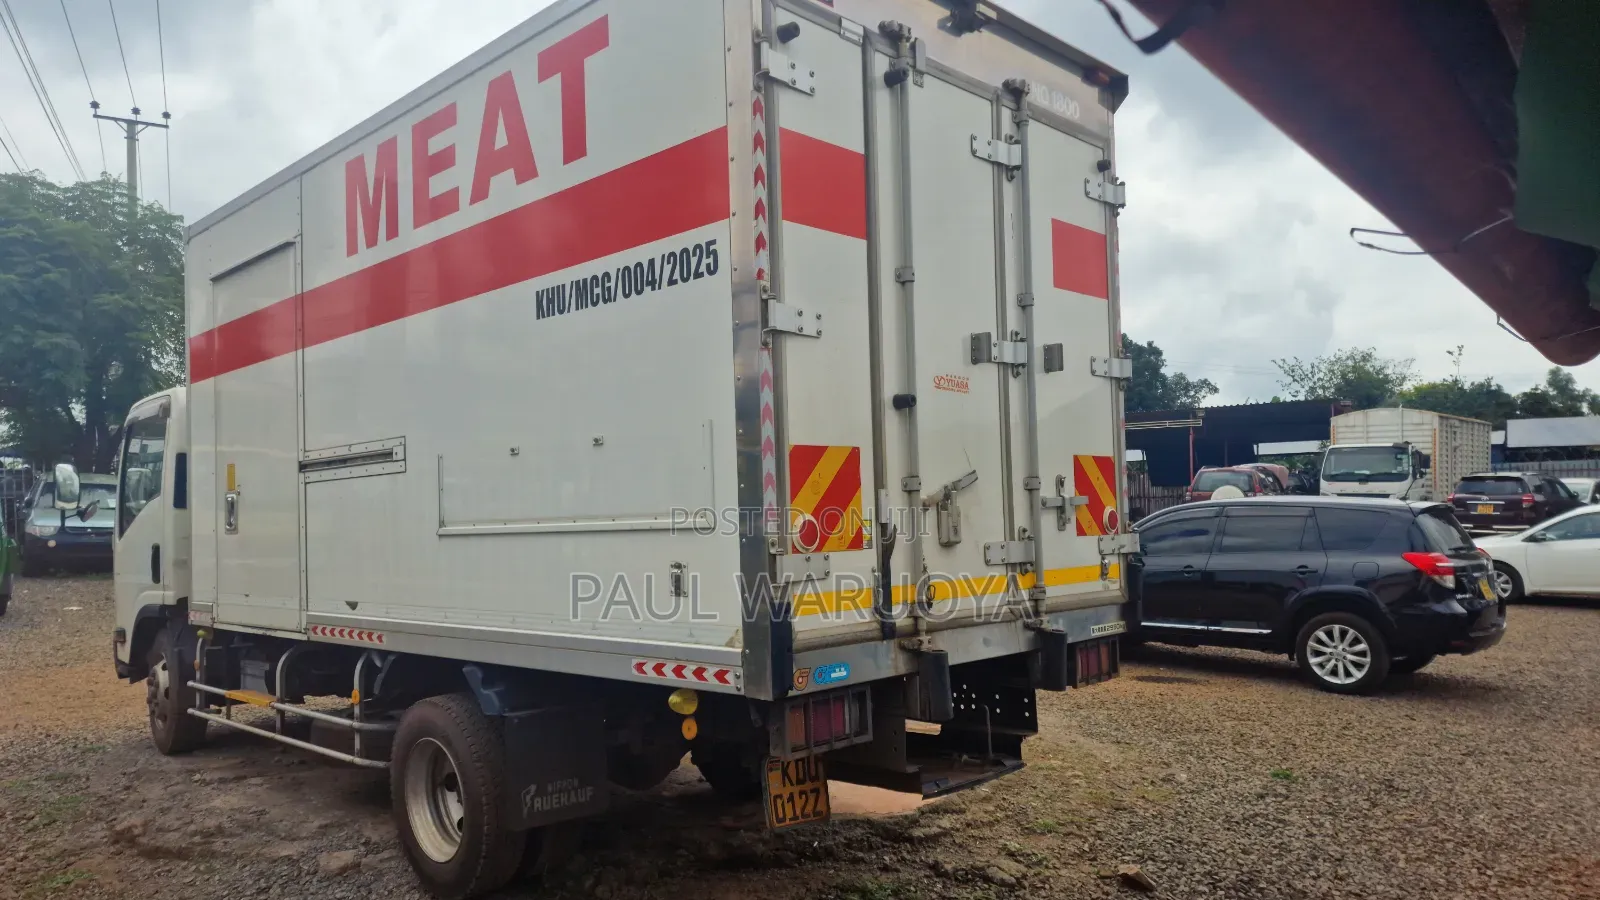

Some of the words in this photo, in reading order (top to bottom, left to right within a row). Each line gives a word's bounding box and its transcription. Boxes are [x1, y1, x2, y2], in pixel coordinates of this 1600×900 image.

[345, 13, 609, 258] MEAT
[535, 238, 719, 321] KHU/MCG/004/2025
[945, 378, 969, 390] YUASA
